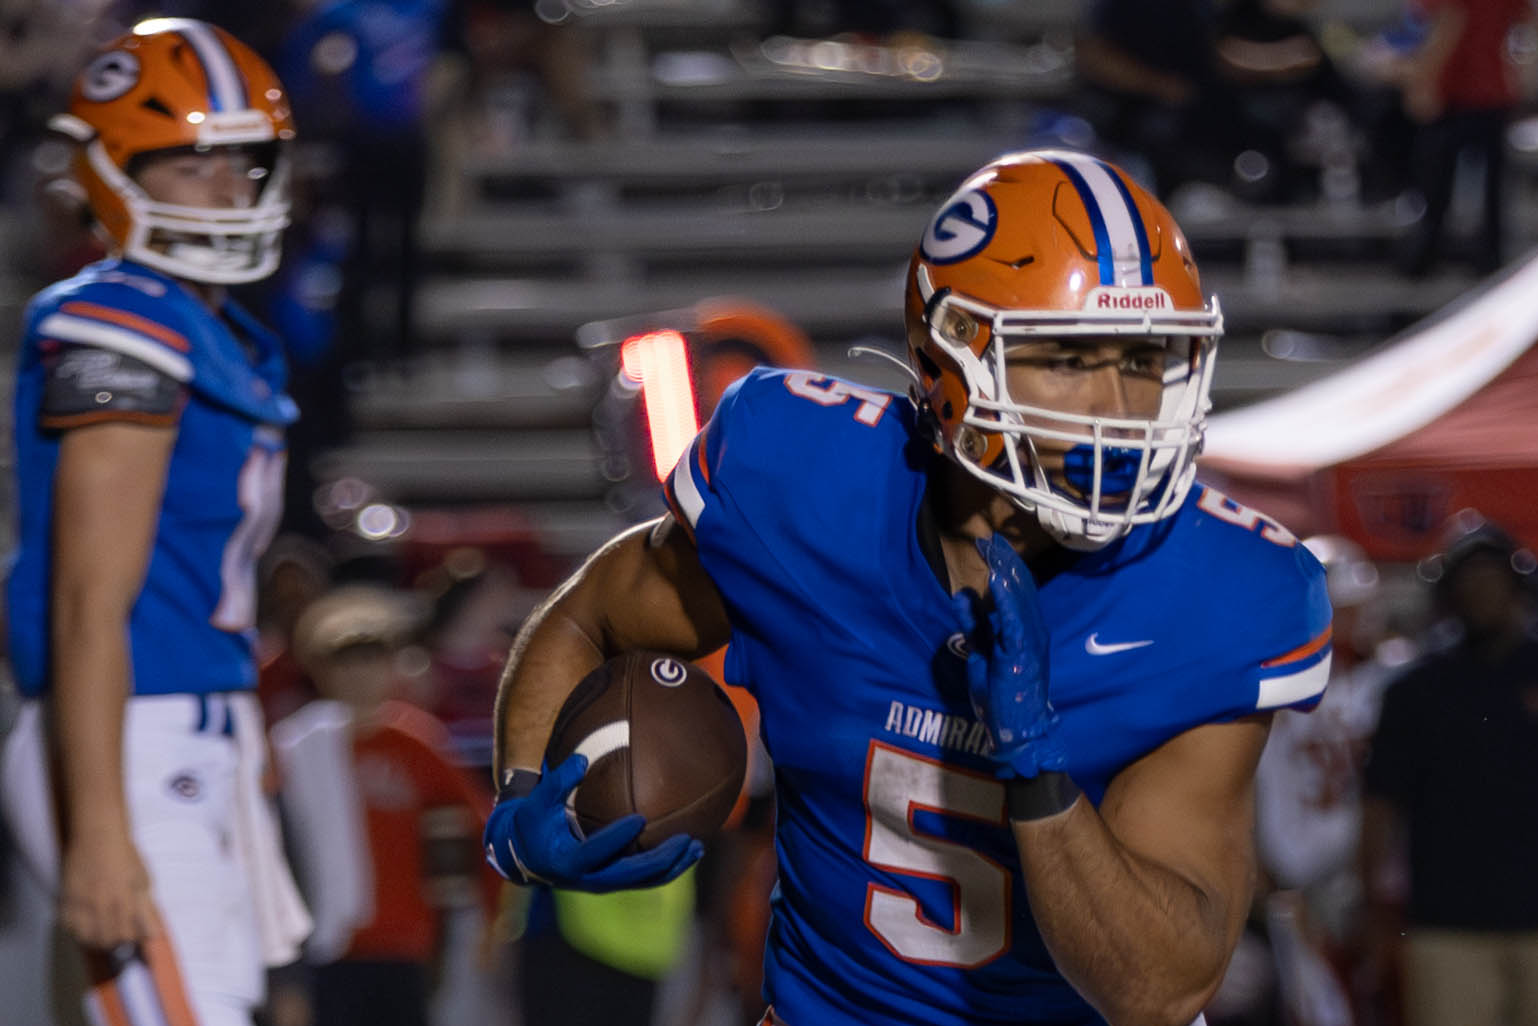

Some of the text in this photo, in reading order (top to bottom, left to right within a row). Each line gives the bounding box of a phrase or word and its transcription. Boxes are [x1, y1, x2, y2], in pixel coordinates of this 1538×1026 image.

[921, 188, 998, 265] G
[1097, 291, 1166, 310] Riddell
[783, 372, 892, 427] 5
[656, 657, 682, 683] G
[884, 700, 991, 757] ADMIRA
[862, 738, 1013, 969] 5
